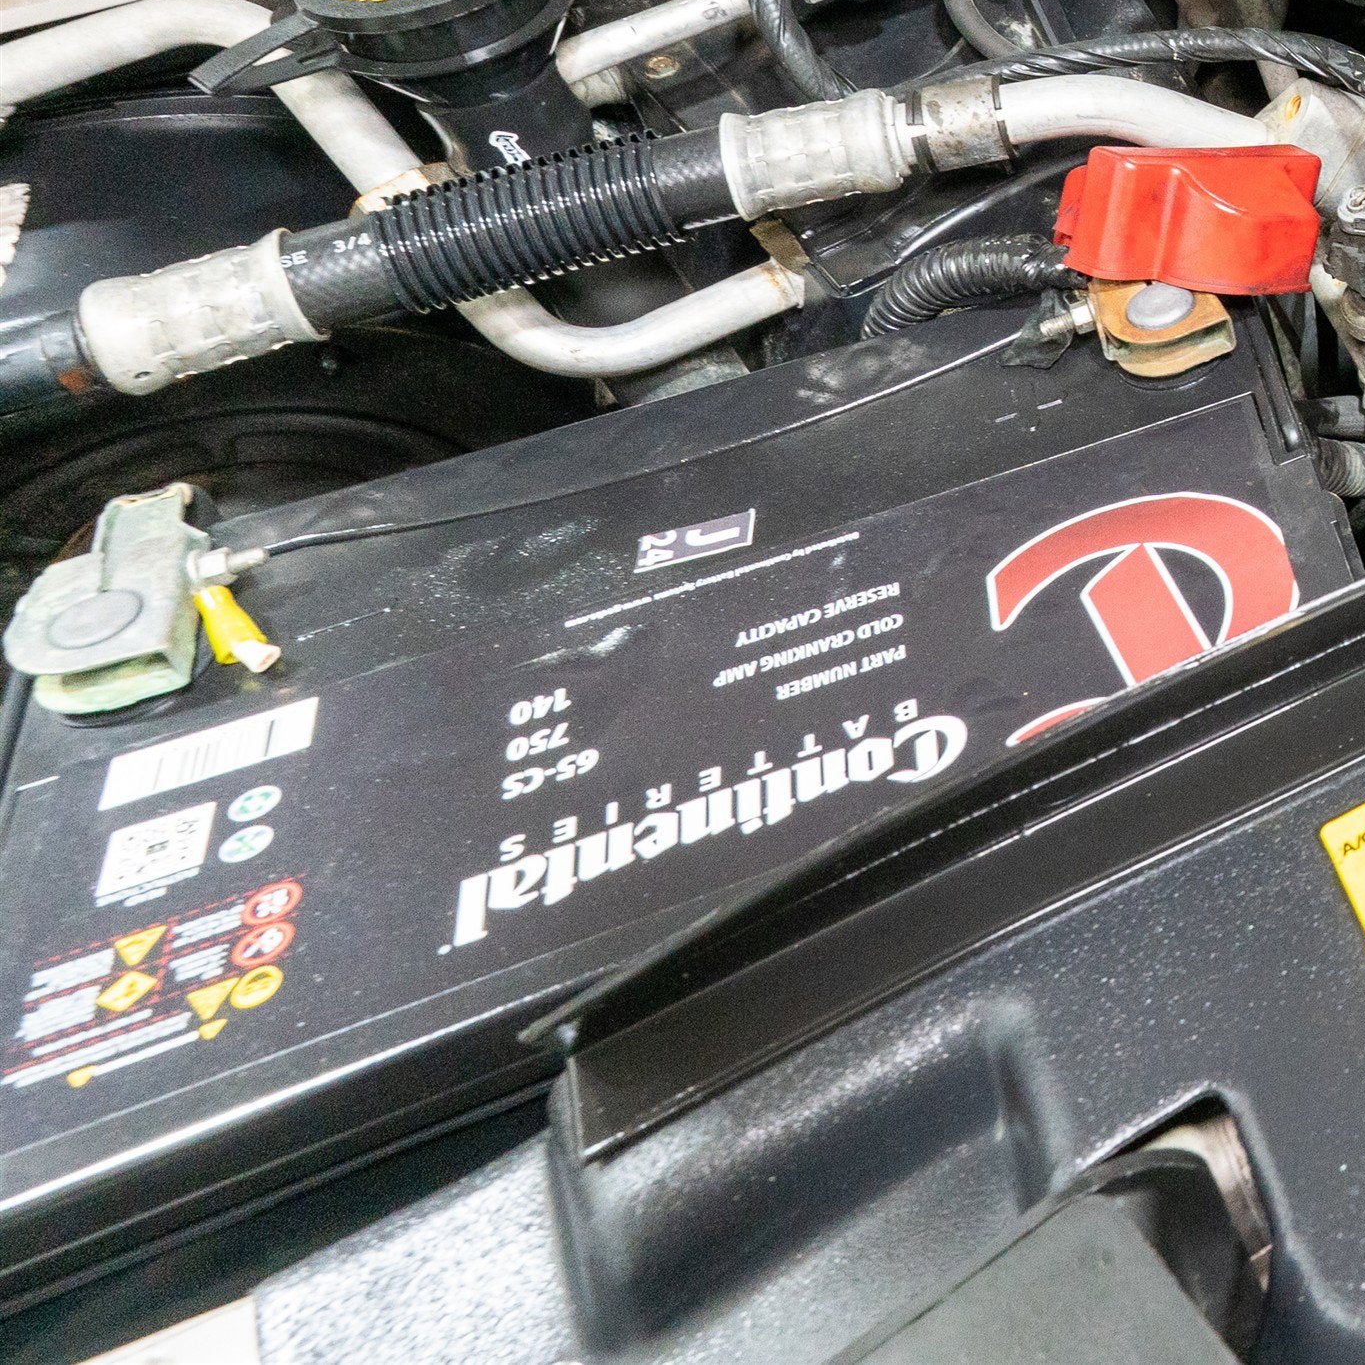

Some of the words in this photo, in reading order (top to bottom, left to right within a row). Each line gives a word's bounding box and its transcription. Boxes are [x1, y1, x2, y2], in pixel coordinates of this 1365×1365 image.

[332, 232, 372, 254] 3/4
[636, 529, 677, 569] 24
[823, 581, 900, 618] RESERVE
[734, 608, 821, 647] CAPACITY
[856, 613, 903, 639] COLD
[759, 629, 855, 671] CRANKING
[859, 644, 906, 672] PART
[712, 660, 757, 687] AMP
[775, 661, 857, 699] NUMBER
[508, 687, 571, 725] 140
[505, 722, 569, 761] 750
[499, 698, 917, 861] BATTERIES
[501, 748, 599, 799] 65-CS
[452, 715, 967, 946] Continental
